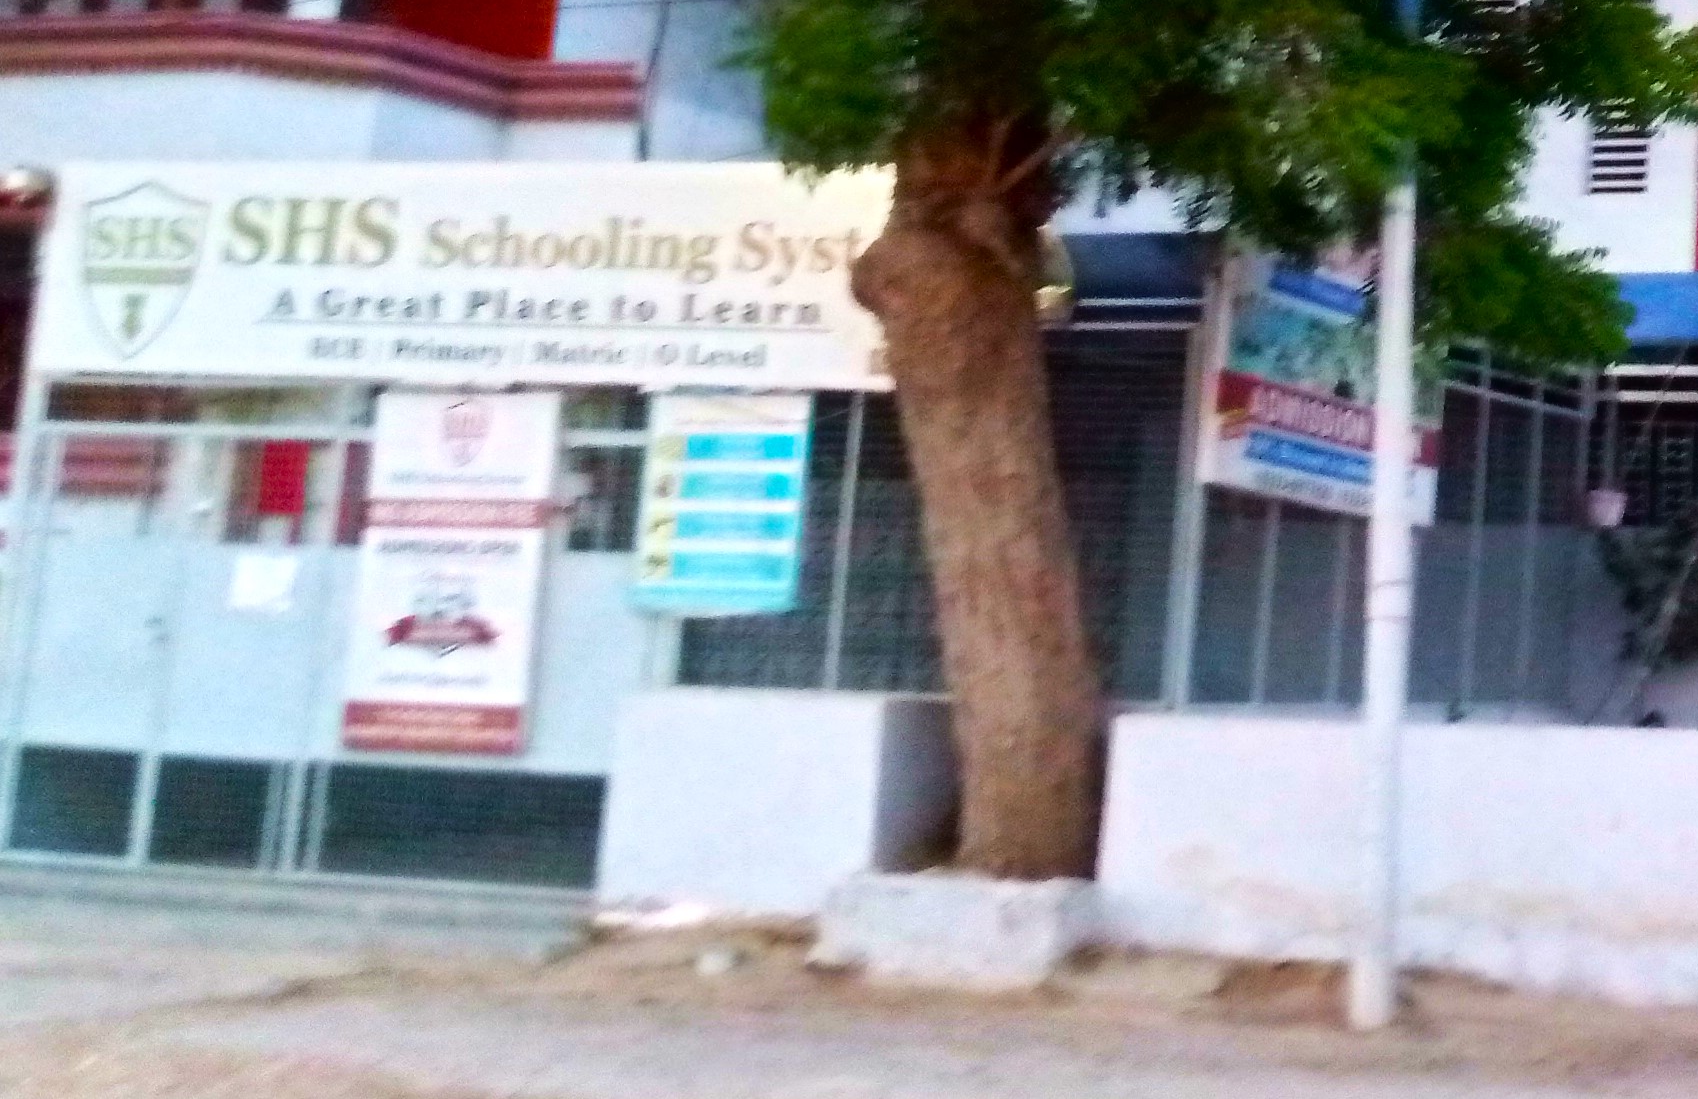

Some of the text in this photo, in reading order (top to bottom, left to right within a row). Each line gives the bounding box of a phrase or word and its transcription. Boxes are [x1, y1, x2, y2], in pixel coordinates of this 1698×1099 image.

[88, 216, 200, 260] SHS
[224, 196, 401, 267] SHS
[421, 215, 720, 285] Schooling
[269, 288, 822, 325] A Great Place to Learn
[393, 338, 504, 367] Primary
[532, 341, 624, 365] Matric
[685, 343, 768, 368] Level
